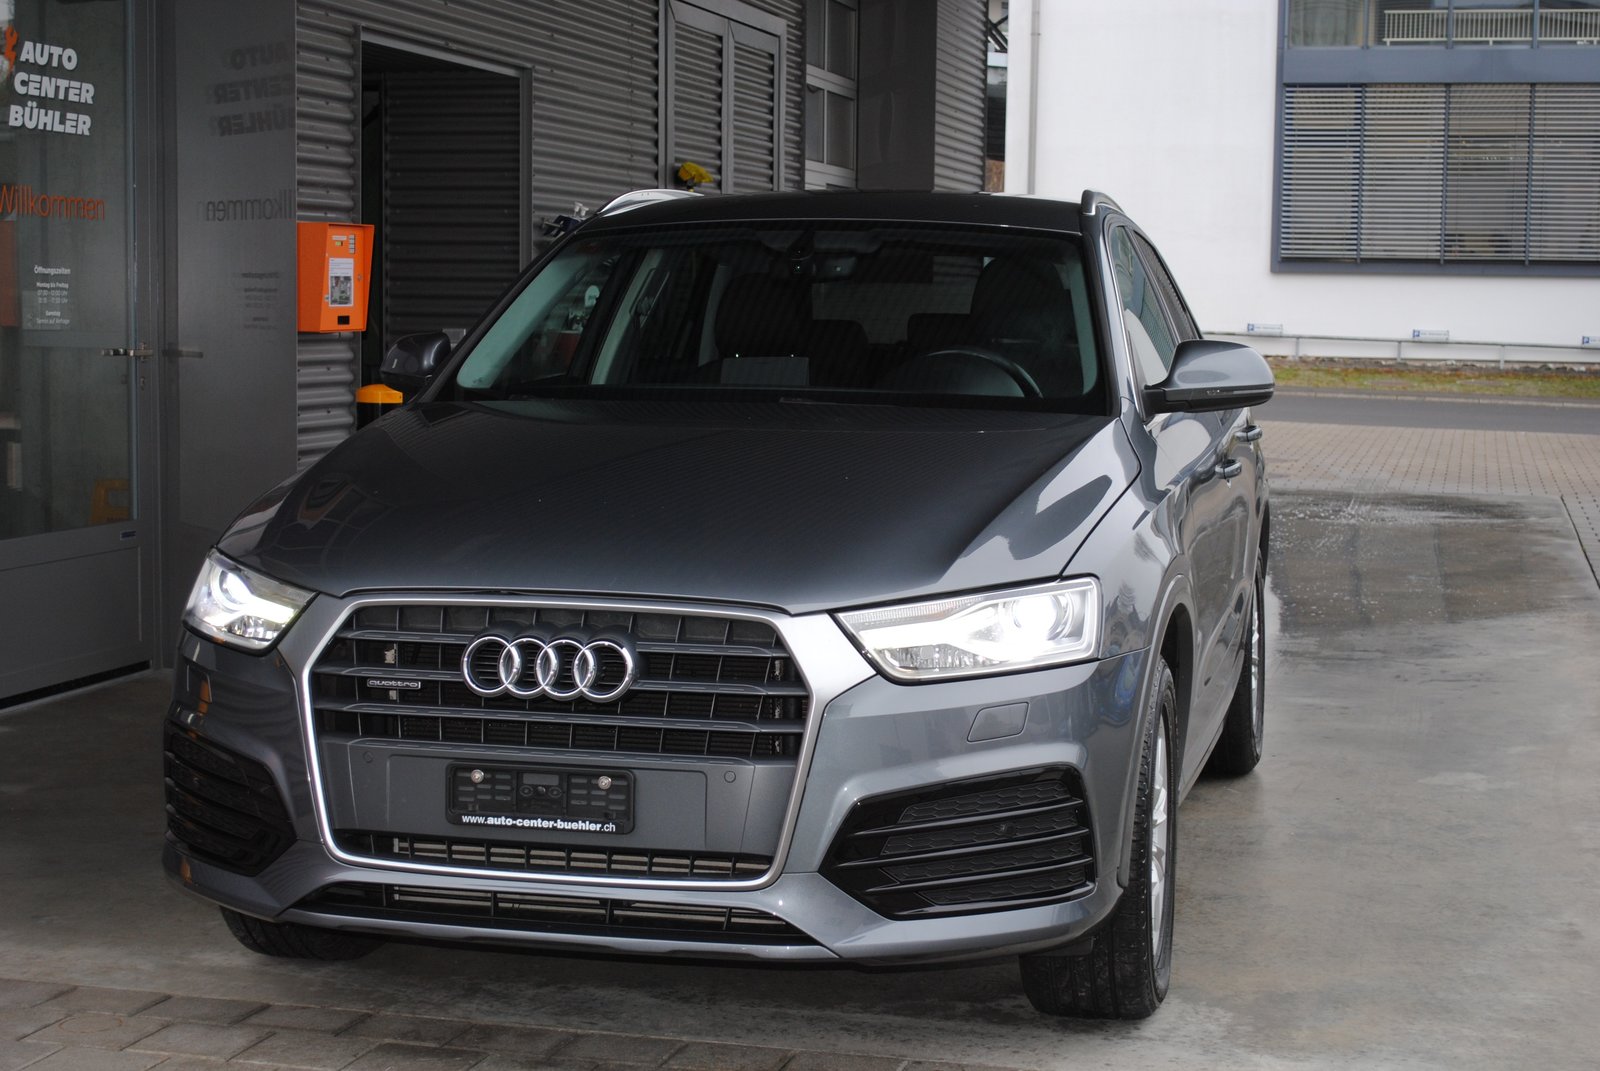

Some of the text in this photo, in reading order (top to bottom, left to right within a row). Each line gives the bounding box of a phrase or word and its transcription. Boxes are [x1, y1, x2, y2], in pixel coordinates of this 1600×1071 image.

[20, 41, 78, 71] AUTO
[13, 71, 95, 104] CENTER
[8, 100, 92, 136] BÜHLER
[0, 184, 105, 221] Willkommen
[33, 265, 71, 276] Öffnungszeiten
[368, 679, 419, 689] quattro
[461, 814, 616, 832] www.auto-center-buehler.ch
